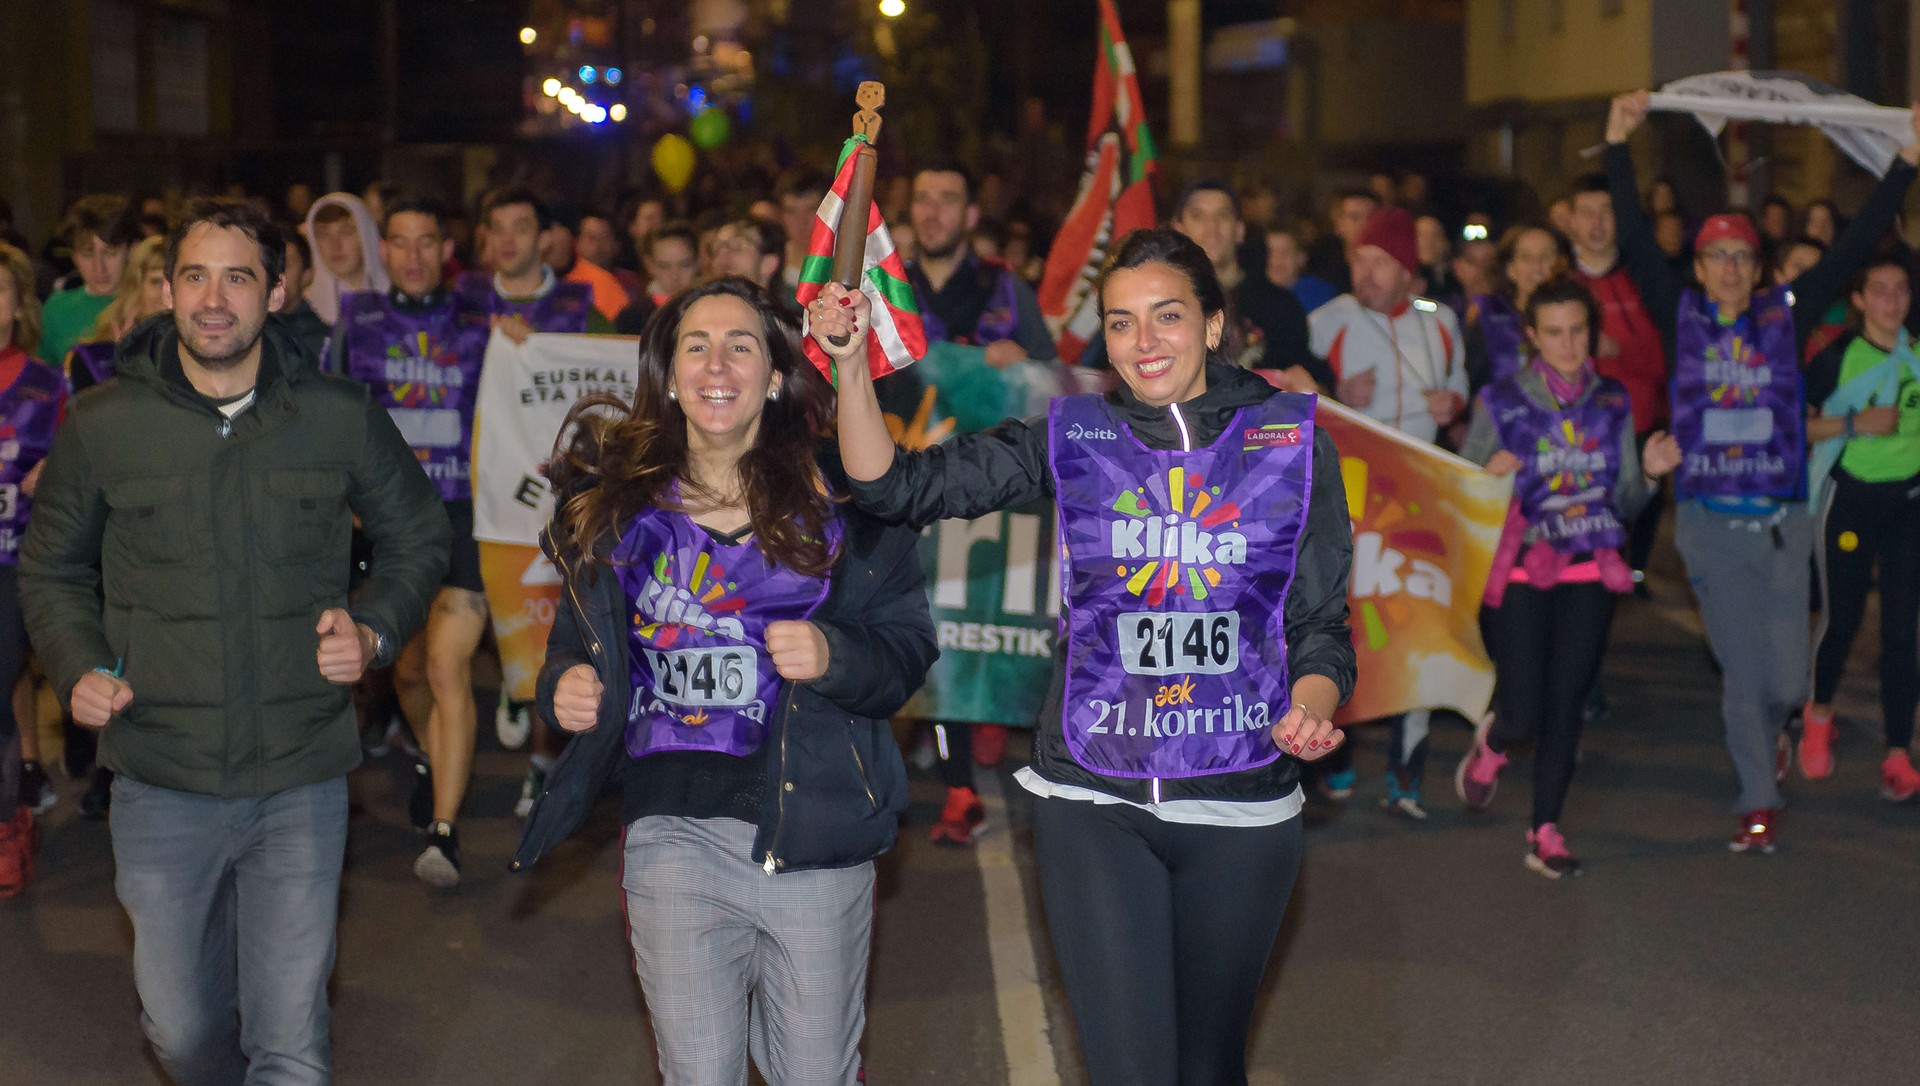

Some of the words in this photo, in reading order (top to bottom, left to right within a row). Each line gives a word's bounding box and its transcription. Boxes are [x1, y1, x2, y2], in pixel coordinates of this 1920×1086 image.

[520, 387, 566, 404] ETA
[532, 367, 631, 386] EUSKAL
[1086, 427, 1118, 440] eitb
[1247, 432, 1287, 440] LABORAL
[1111, 513, 1248, 565] Klika
[1350, 525, 1453, 608] ka
[635, 575, 745, 642] Klika
[938, 620, 1053, 658] RESTIK
[1136, 616, 1230, 668] 2146
[655, 652, 744, 700] 2146
[1154, 674, 1196, 707] aek
[1086, 699, 1137, 737] 21.
[1143, 693, 1270, 738] korrika
